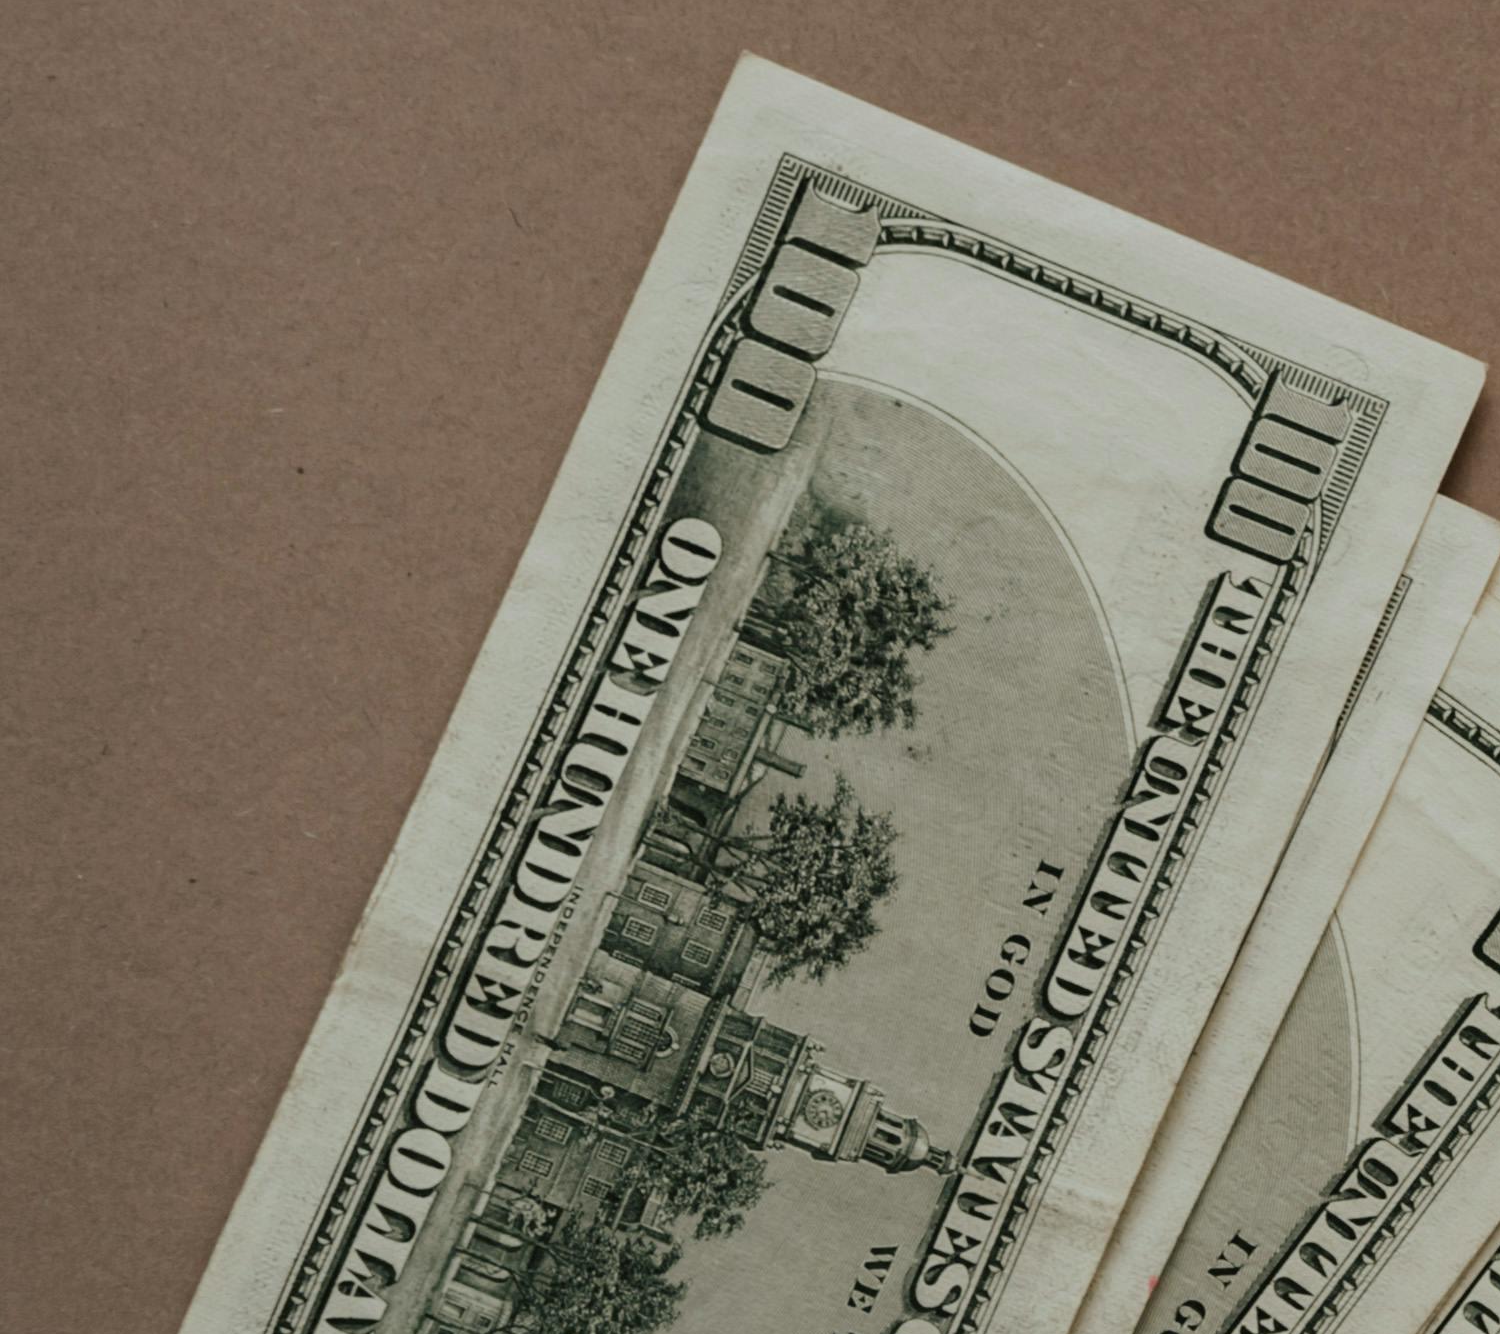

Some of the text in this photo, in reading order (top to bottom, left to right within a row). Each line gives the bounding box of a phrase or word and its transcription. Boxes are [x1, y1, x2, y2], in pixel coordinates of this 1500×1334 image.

[692, 170, 891, 465] 100
[1200, 366, 1360, 572] 100
[601, 505, 731, 693] ONE
[1150, 566, 1269, 744] THE
[429, 666, 660, 1088] HUNDRED
[962, 856, 1065, 1043] IN GOD
[1026, 725, 1200, 1032] UNITED
[485, 883, 583, 1093] INDEPENDENCE HALL
[900, 1011, 1078, 1329] STATES
[1200, 1225, 1260, 1292] IN
[841, 1235, 899, 1317] WE
